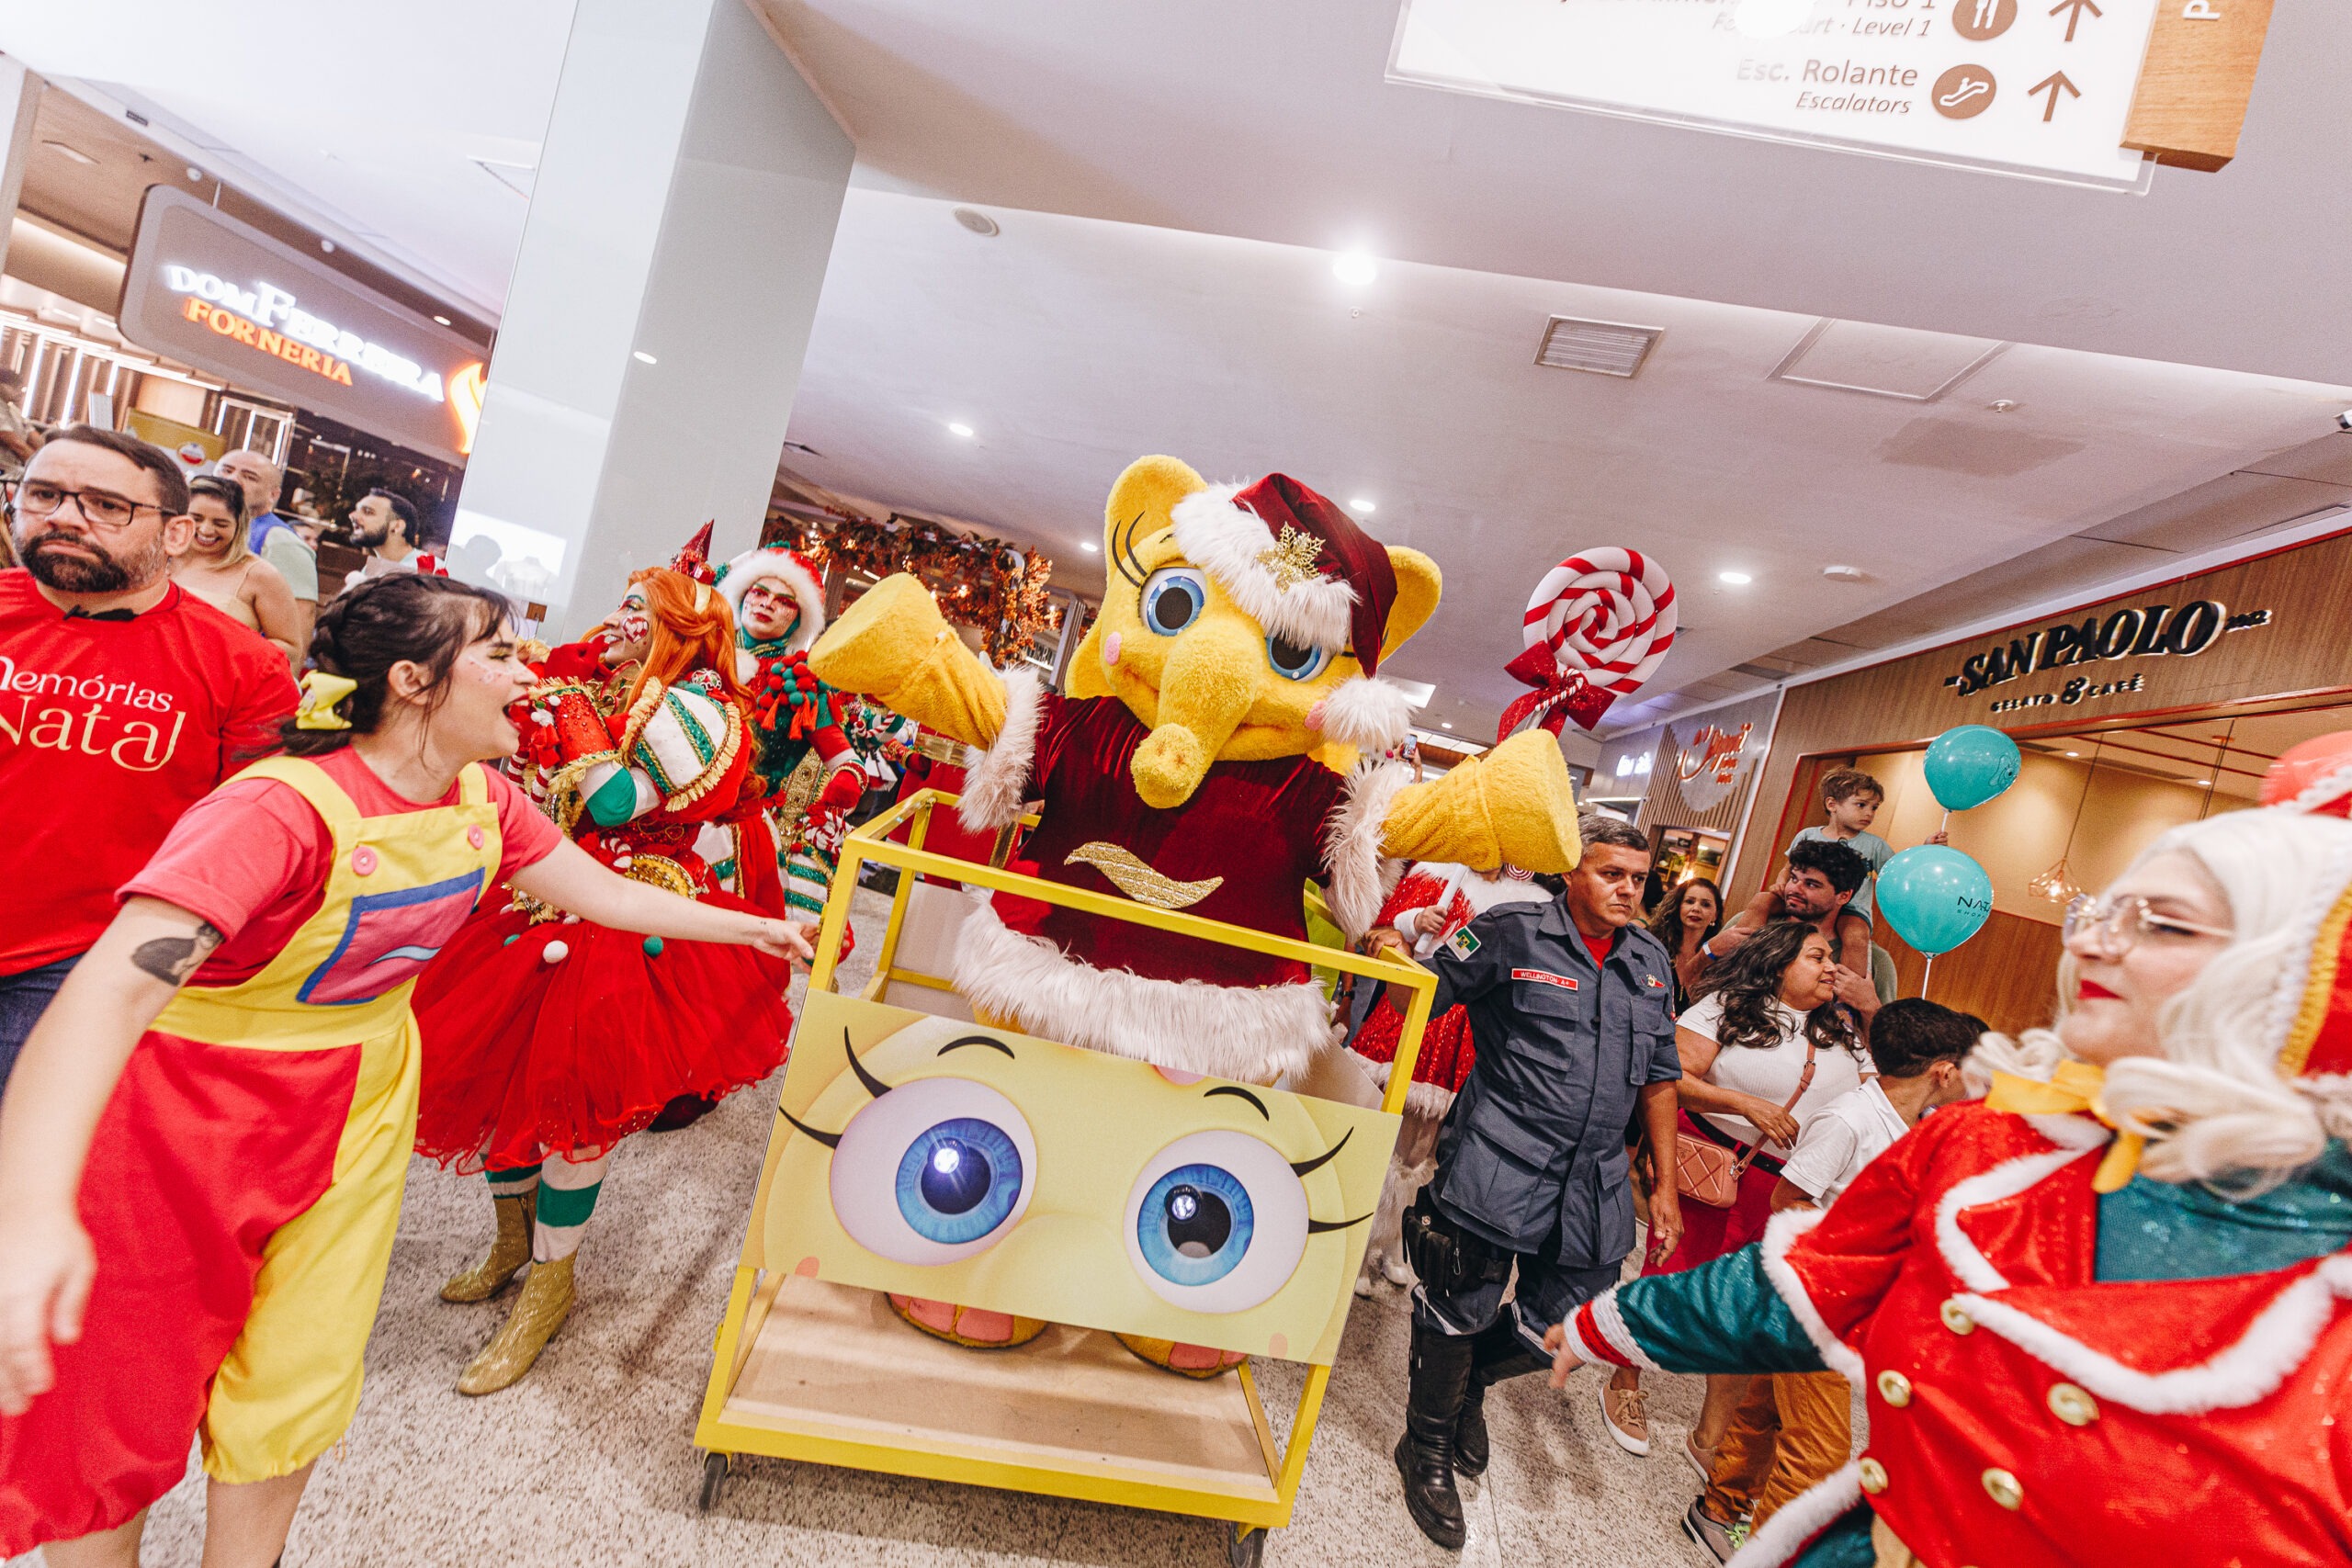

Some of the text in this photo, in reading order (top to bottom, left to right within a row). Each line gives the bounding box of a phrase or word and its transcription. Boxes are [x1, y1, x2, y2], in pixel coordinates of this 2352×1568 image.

[1851, 17, 1914, 36] Level
[1917, 19, 1932, 37] 1
[1736, 58, 1919, 87] Esc. Rolante
[1795, 92, 1913, 114] Escalators
[185, 296, 354, 387] FORNERIA
[1958, 600, 2227, 697] SAN PAOLO
[1990, 672, 2145, 714] GELATO & CAFÉ
[1520, 971, 1559, 984] WELLINGTON
